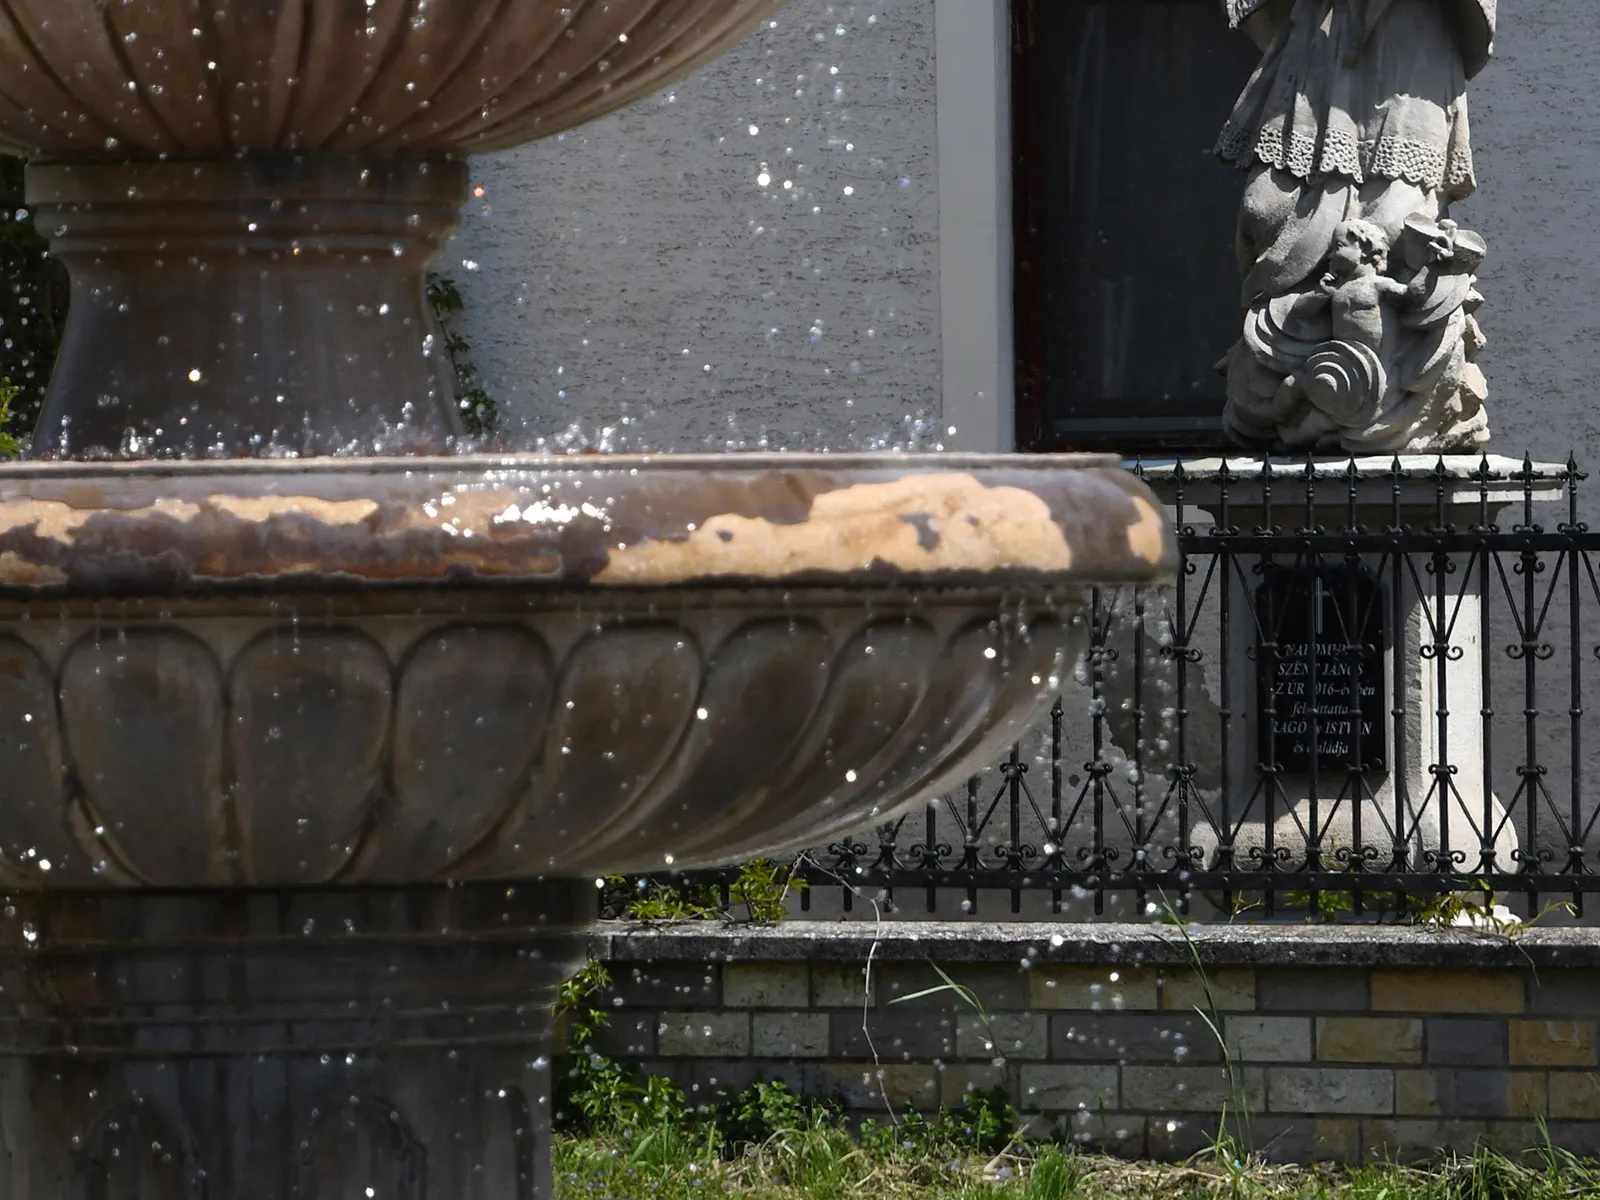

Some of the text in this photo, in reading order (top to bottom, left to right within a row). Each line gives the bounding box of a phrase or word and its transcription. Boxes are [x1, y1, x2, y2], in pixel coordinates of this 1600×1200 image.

[1287, 678, 1305, 695] ÚR
[1325, 720, 1372, 735] ISTVN
[1293, 740, 1349, 757] és caládja
